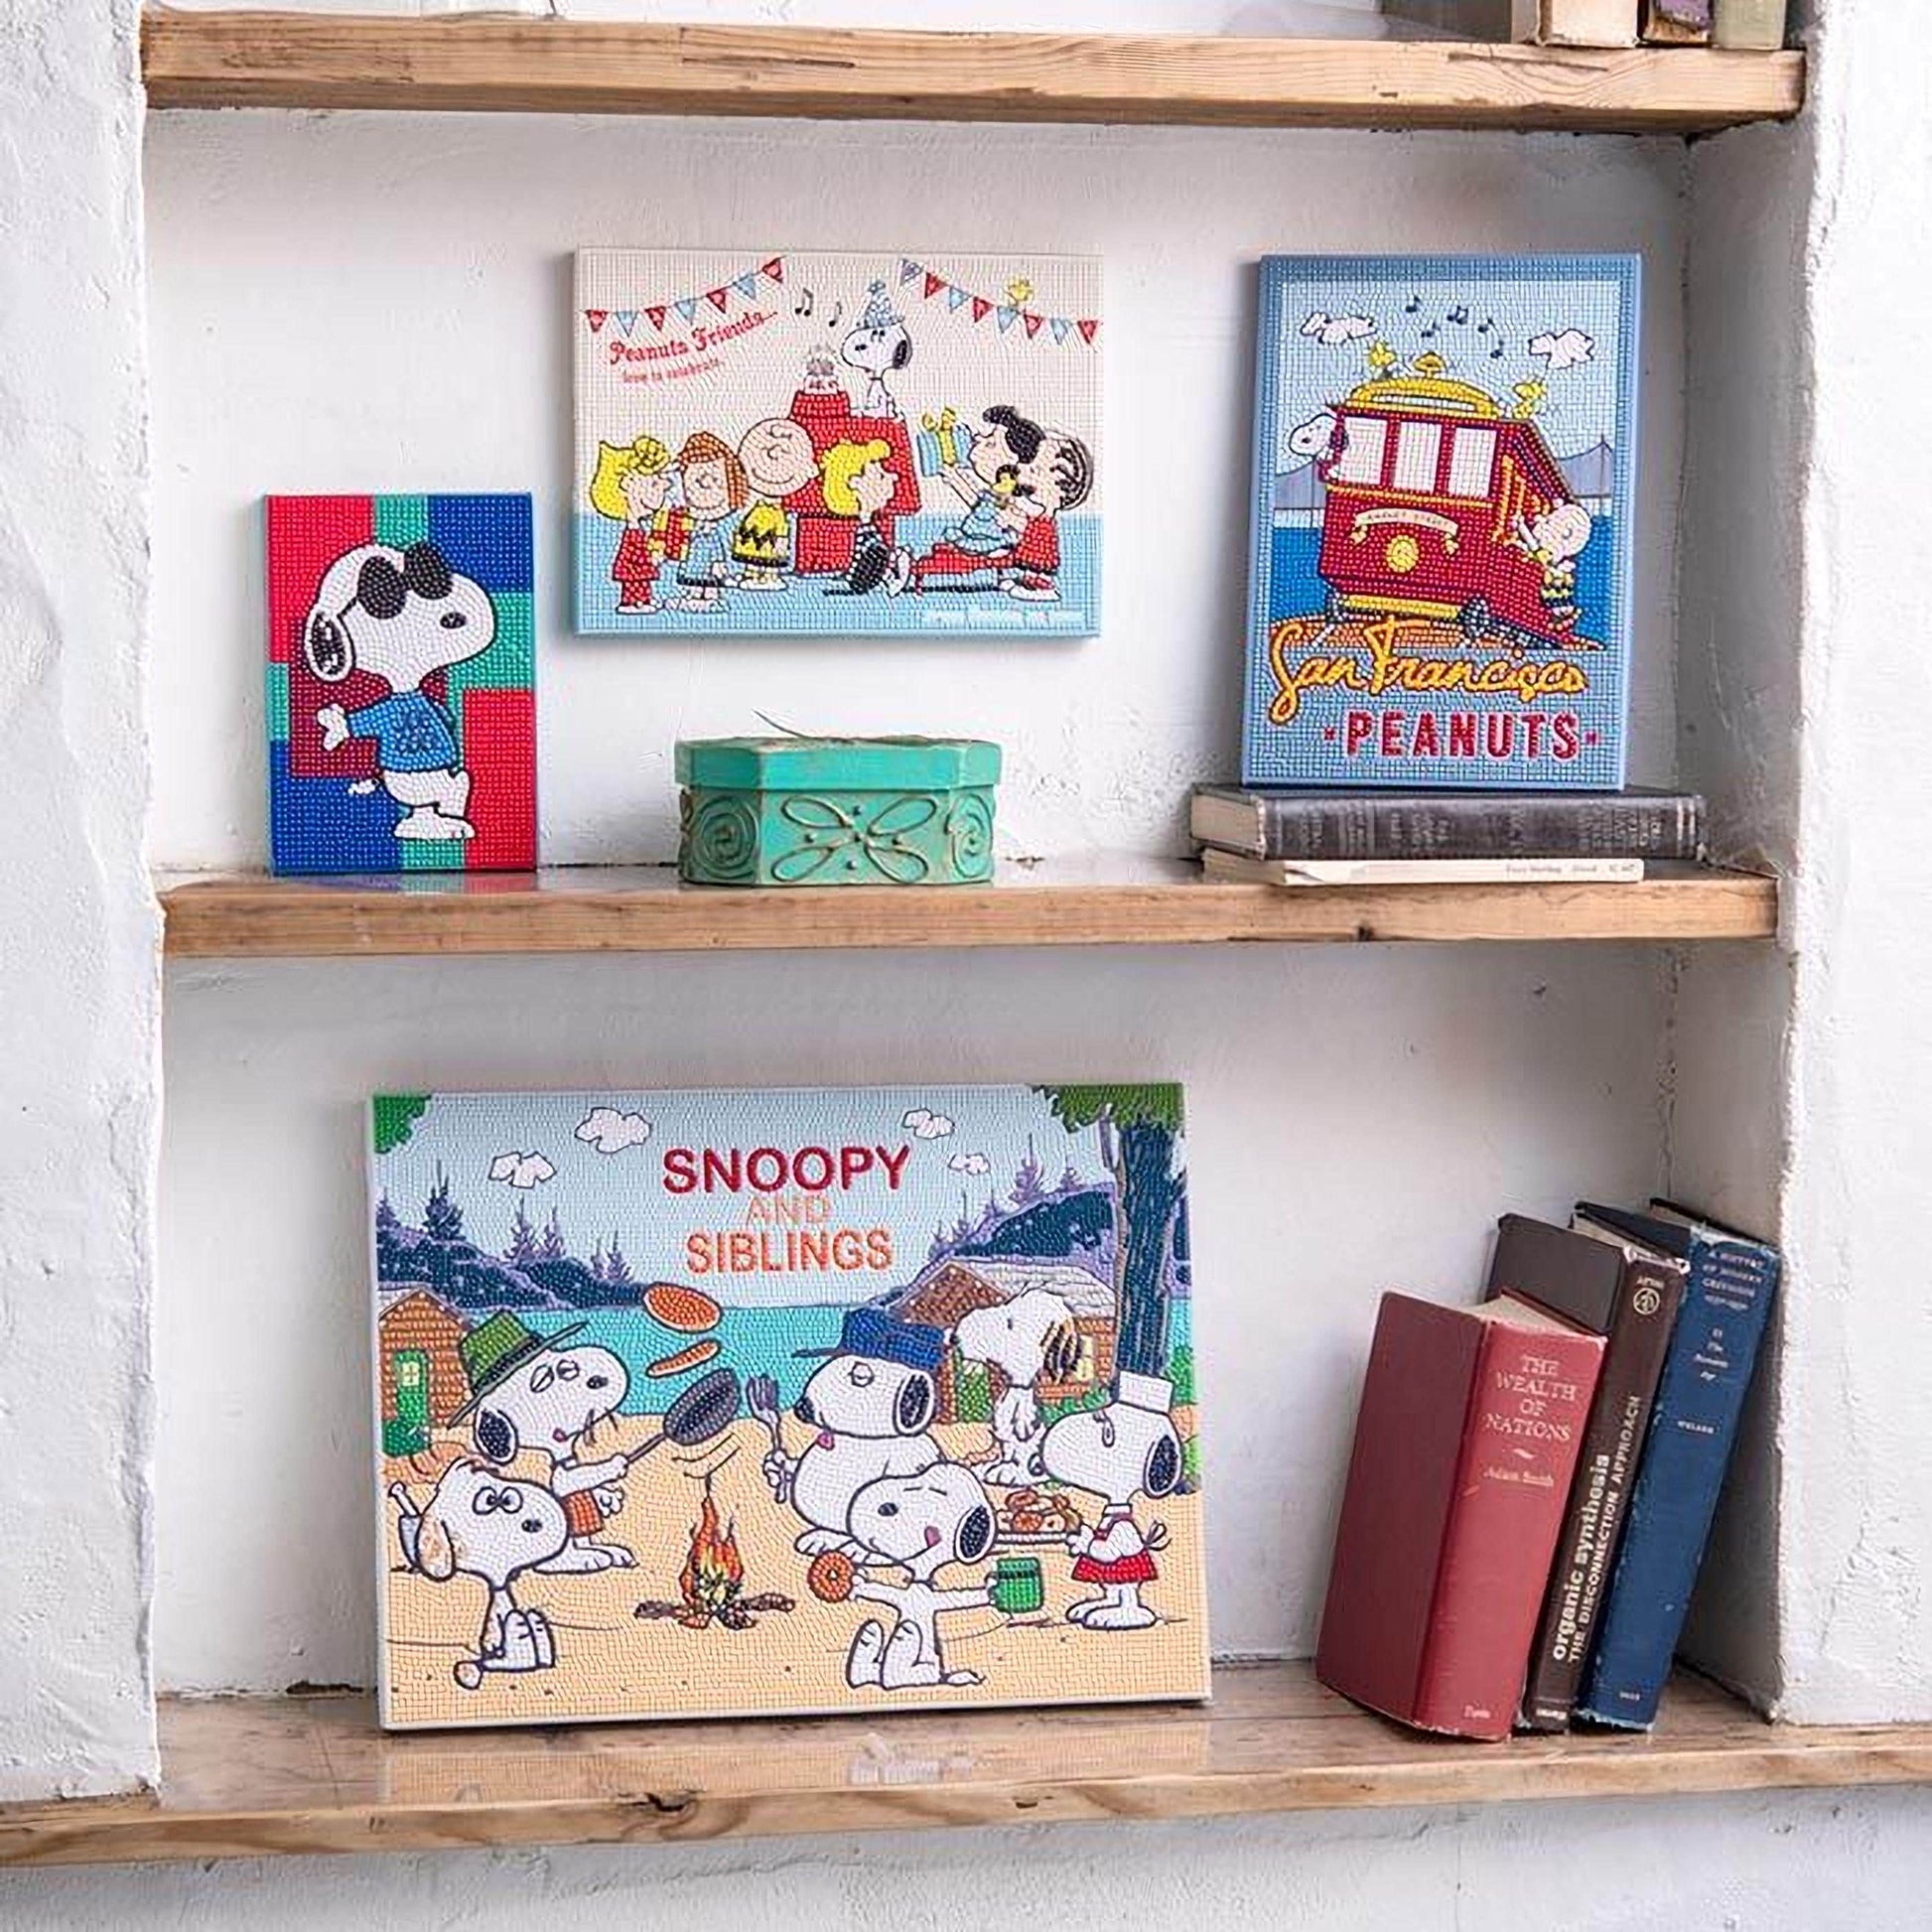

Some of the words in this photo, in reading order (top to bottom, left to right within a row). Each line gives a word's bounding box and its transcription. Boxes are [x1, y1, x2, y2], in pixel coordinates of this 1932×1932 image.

[610, 340, 689, 364] Peanuts
[691, 312, 778, 351] Friends
[1268, 620, 1367, 725] San
[1362, 615, 1588, 703] Francisco
[1346, 710, 1581, 759] PEANUTS
[662, 1144, 910, 1193] SNOOPY
[747, 1194, 831, 1224] AND
[686, 1229, 893, 1274] SIBLINGS
[1496, 1368, 1577, 1402] WEALTH
[1520, 1352, 1561, 1377] THE
[1482, 1412, 1571, 1442] NATIONS
[1519, 1397, 1549, 1418] OF
[1568, 1627, 1587, 1664] THE
[1578, 1492, 1619, 1624] DISCONNECTION
[1610, 1394, 1640, 1484] APPROACH
